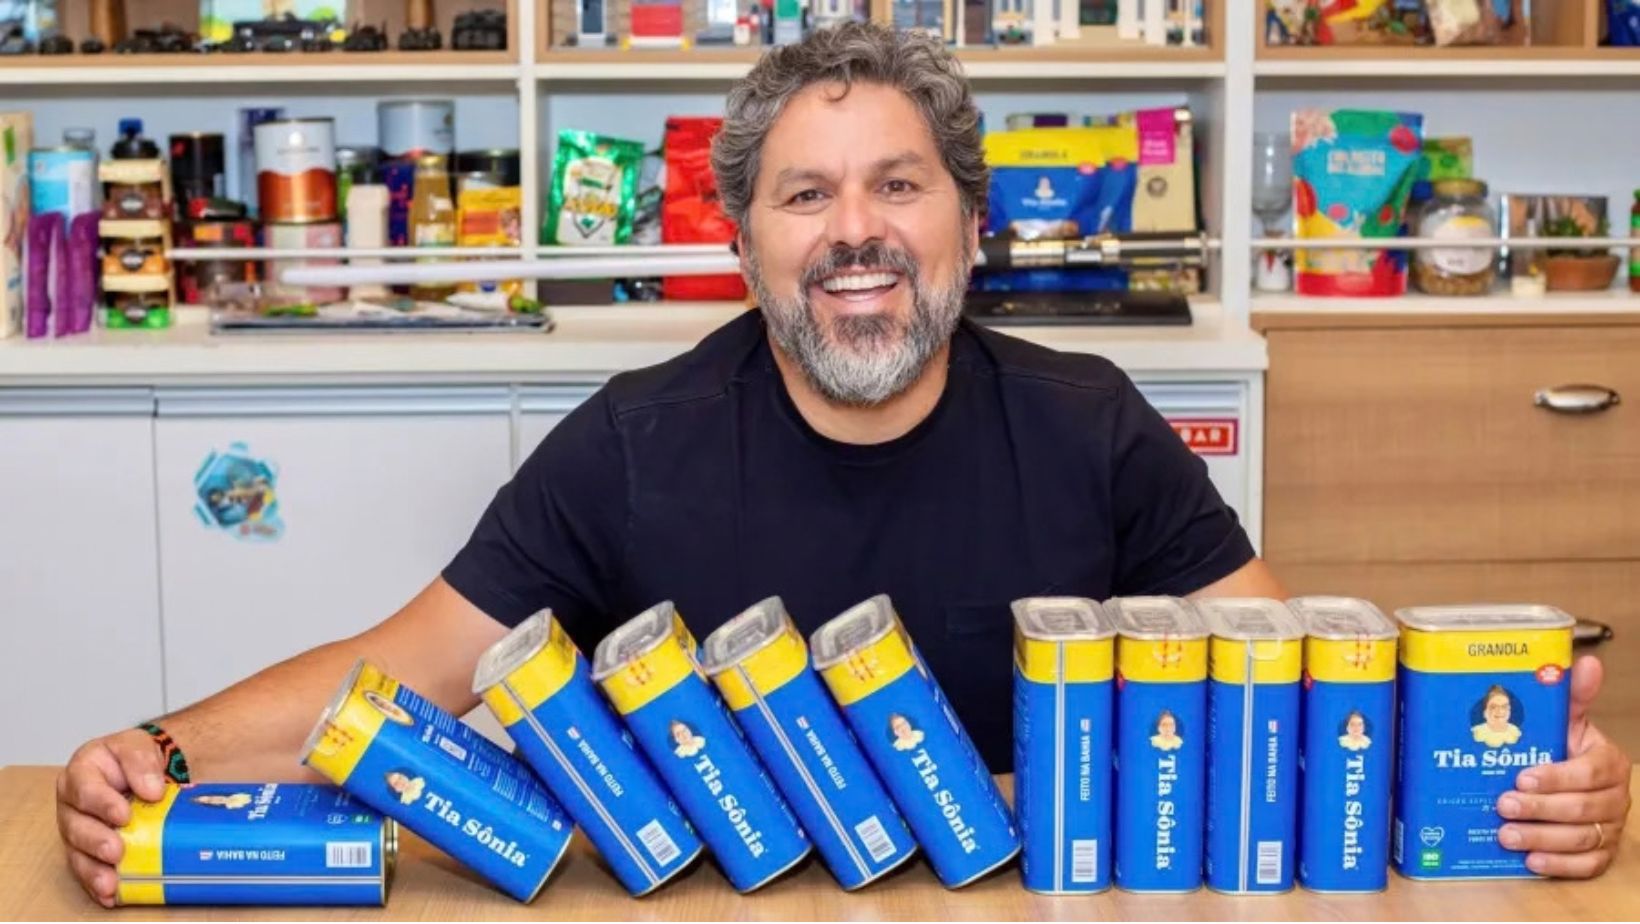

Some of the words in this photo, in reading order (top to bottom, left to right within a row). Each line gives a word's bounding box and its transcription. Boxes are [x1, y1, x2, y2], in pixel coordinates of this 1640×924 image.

[1468, 643, 1529, 656] GRANOLA
[578, 739, 600, 767] BAHIA
[806, 729, 826, 757] BAHIA
[1080, 735, 1090, 763] BAHIA
[1267, 736, 1278, 763] BAHIA
[595, 761, 609, 776] NA
[821, 753, 834, 768] NA
[1080, 762, 1090, 776] NA
[1433, 748, 1477, 767] Tia
[1481, 747, 1553, 767] Sônia
[828, 766, 847, 790] FEITO
[1158, 755, 1178, 796] Tia
[1267, 764, 1277, 778] NA
[1346, 755, 1365, 796] Tia
[604, 772, 624, 797] FEITO
[1080, 777, 1090, 801] FEITO
[1265, 779, 1277, 802] FEITO
[695, 754, 721, 796] Tia
[718, 794, 765, 858] Sônia
[911, 748, 938, 791] Tia
[933, 789, 978, 854] Sônia
[424, 792, 461, 827] Tia
[462, 819, 527, 868] Sônia
[1156, 801, 1176, 870] Sônia
[1342, 801, 1363, 870] Sônia
[216, 850, 245, 861] BAHIA
[245, 850, 260, 861] NA
[260, 850, 286, 861] FEITO
